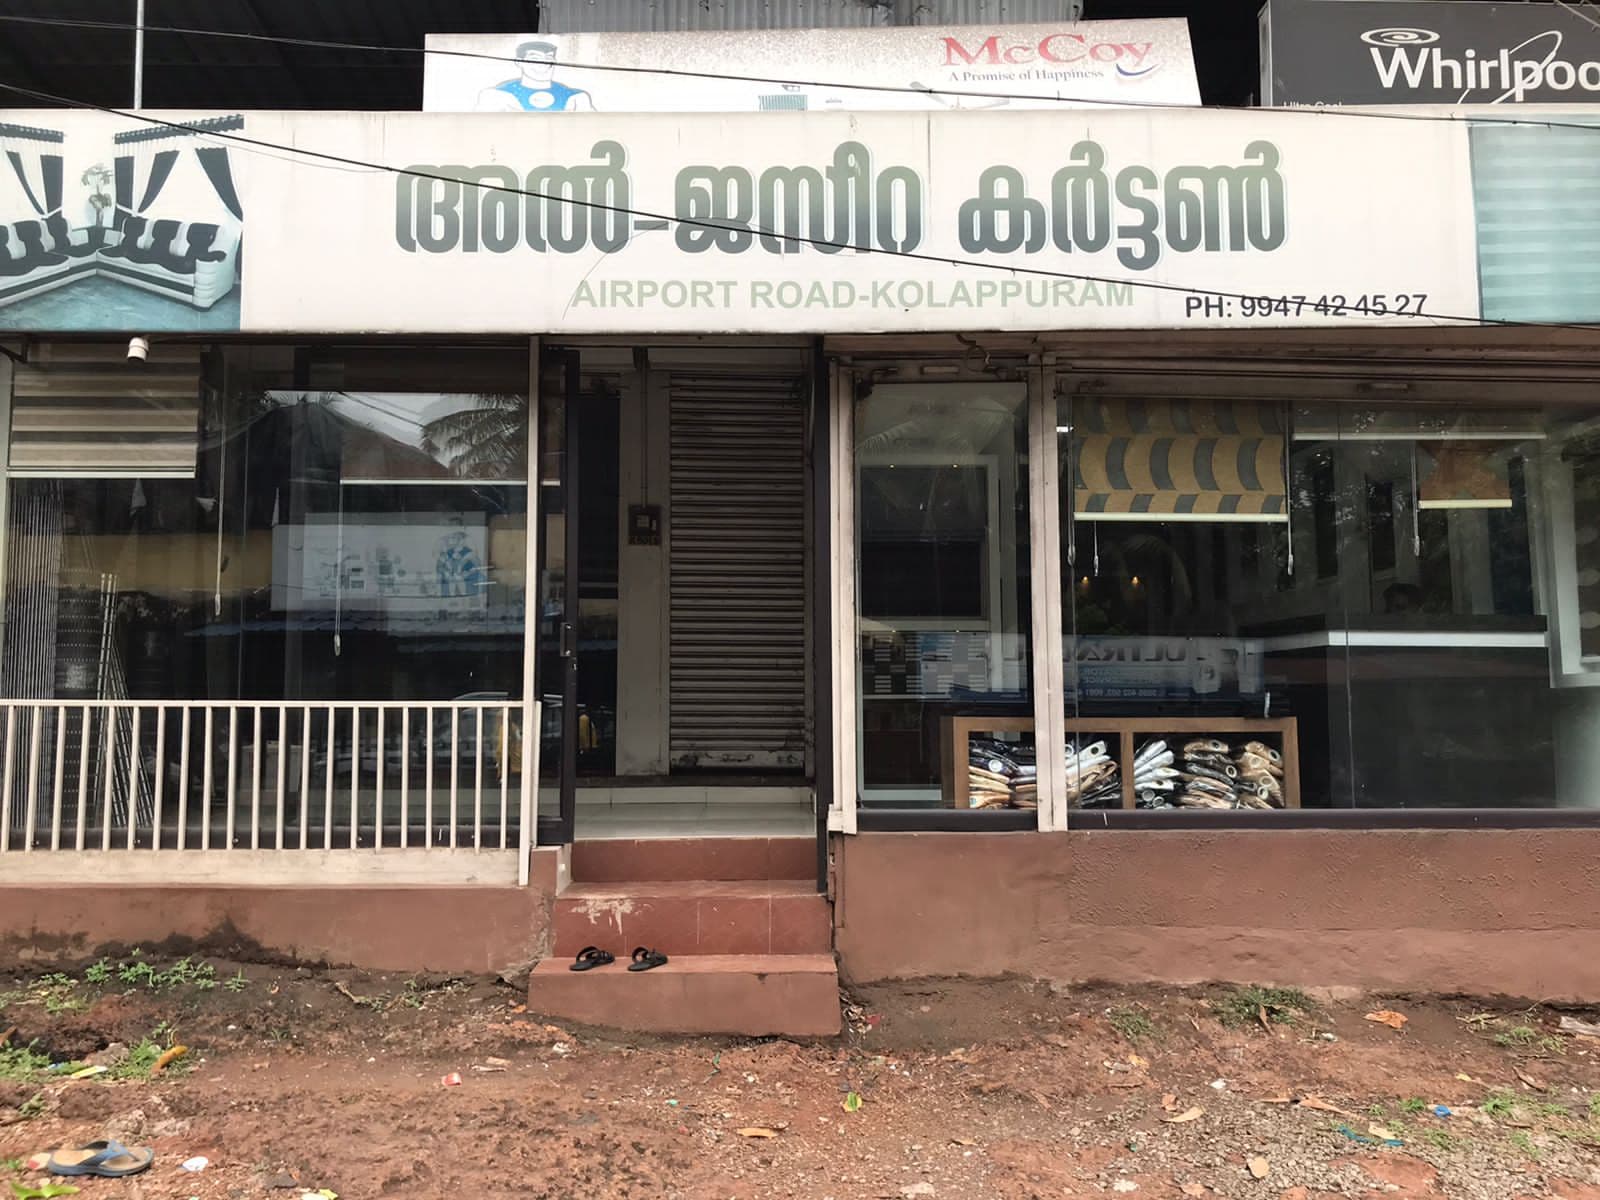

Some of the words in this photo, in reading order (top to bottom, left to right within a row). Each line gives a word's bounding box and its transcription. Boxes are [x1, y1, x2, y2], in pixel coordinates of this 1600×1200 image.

[939, 33, 1153, 66] McCoy
[949, 71, 960, 82] A
[963, 70, 1016, 82] Promise
[1018, 69, 1032, 81] of
[1035, 69, 1105, 82] Happiness
[571, 279, 738, 309] AIRPORT
[750, 279, 1135, 310] ROAD-KOLAPPURAM
[1185, 296, 1232, 318] PH:
[1239, 295, 1307, 318] 9947
[1313, 295, 1347, 317] 42
[1354, 294, 1388, 316] 45
[1394, 294, 1428, 318] 27
